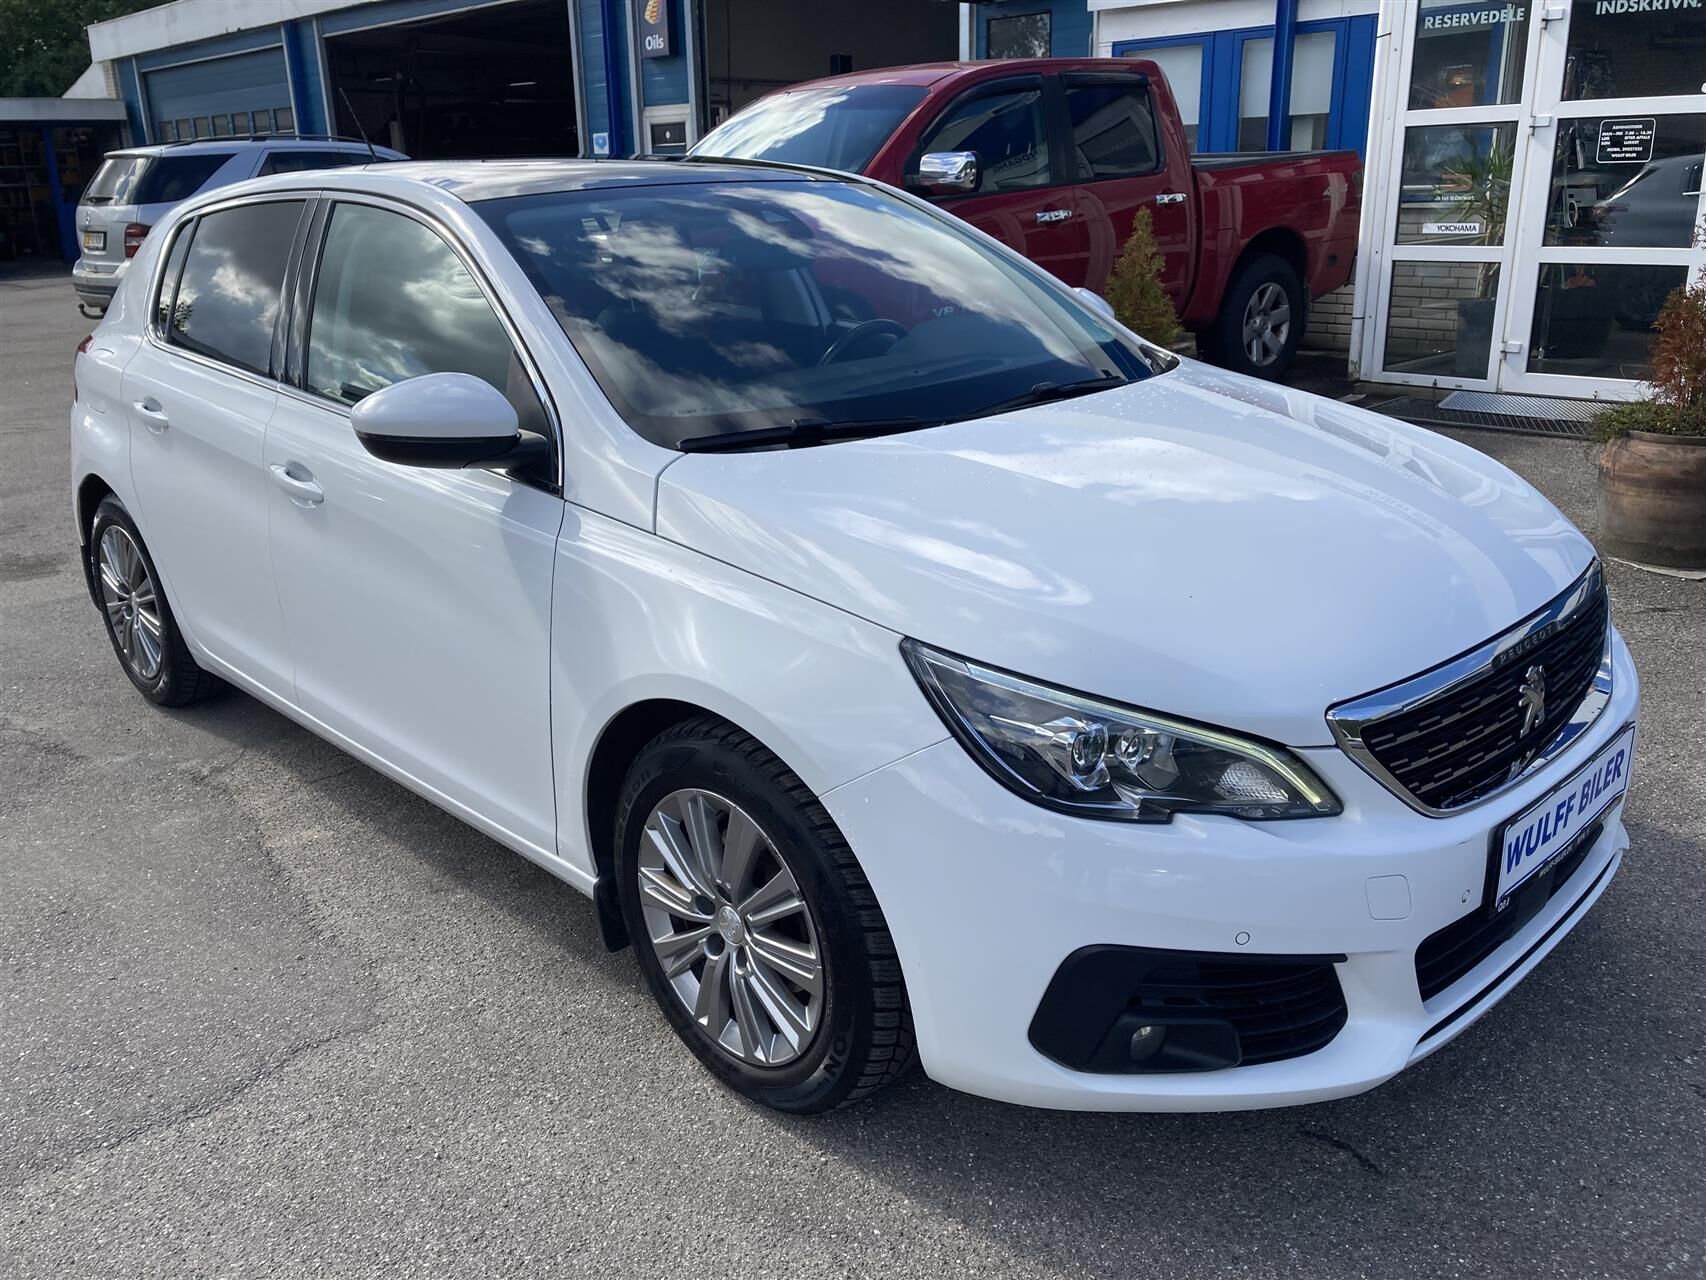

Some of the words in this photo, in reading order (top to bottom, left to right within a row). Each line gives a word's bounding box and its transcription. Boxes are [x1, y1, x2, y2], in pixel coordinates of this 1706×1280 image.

[1595, 0, 1702, 15] INDSKRIVN.
[1424, 7, 1525, 29] RESERVEDELE
[645, 34, 664, 50] Oils
[1437, 224, 1477, 232] YOKOHAMA
[1500, 625, 1552, 664] PEUGEOT
[1506, 791, 1577, 875] WULFF
[1577, 748, 1625, 816] BILER
